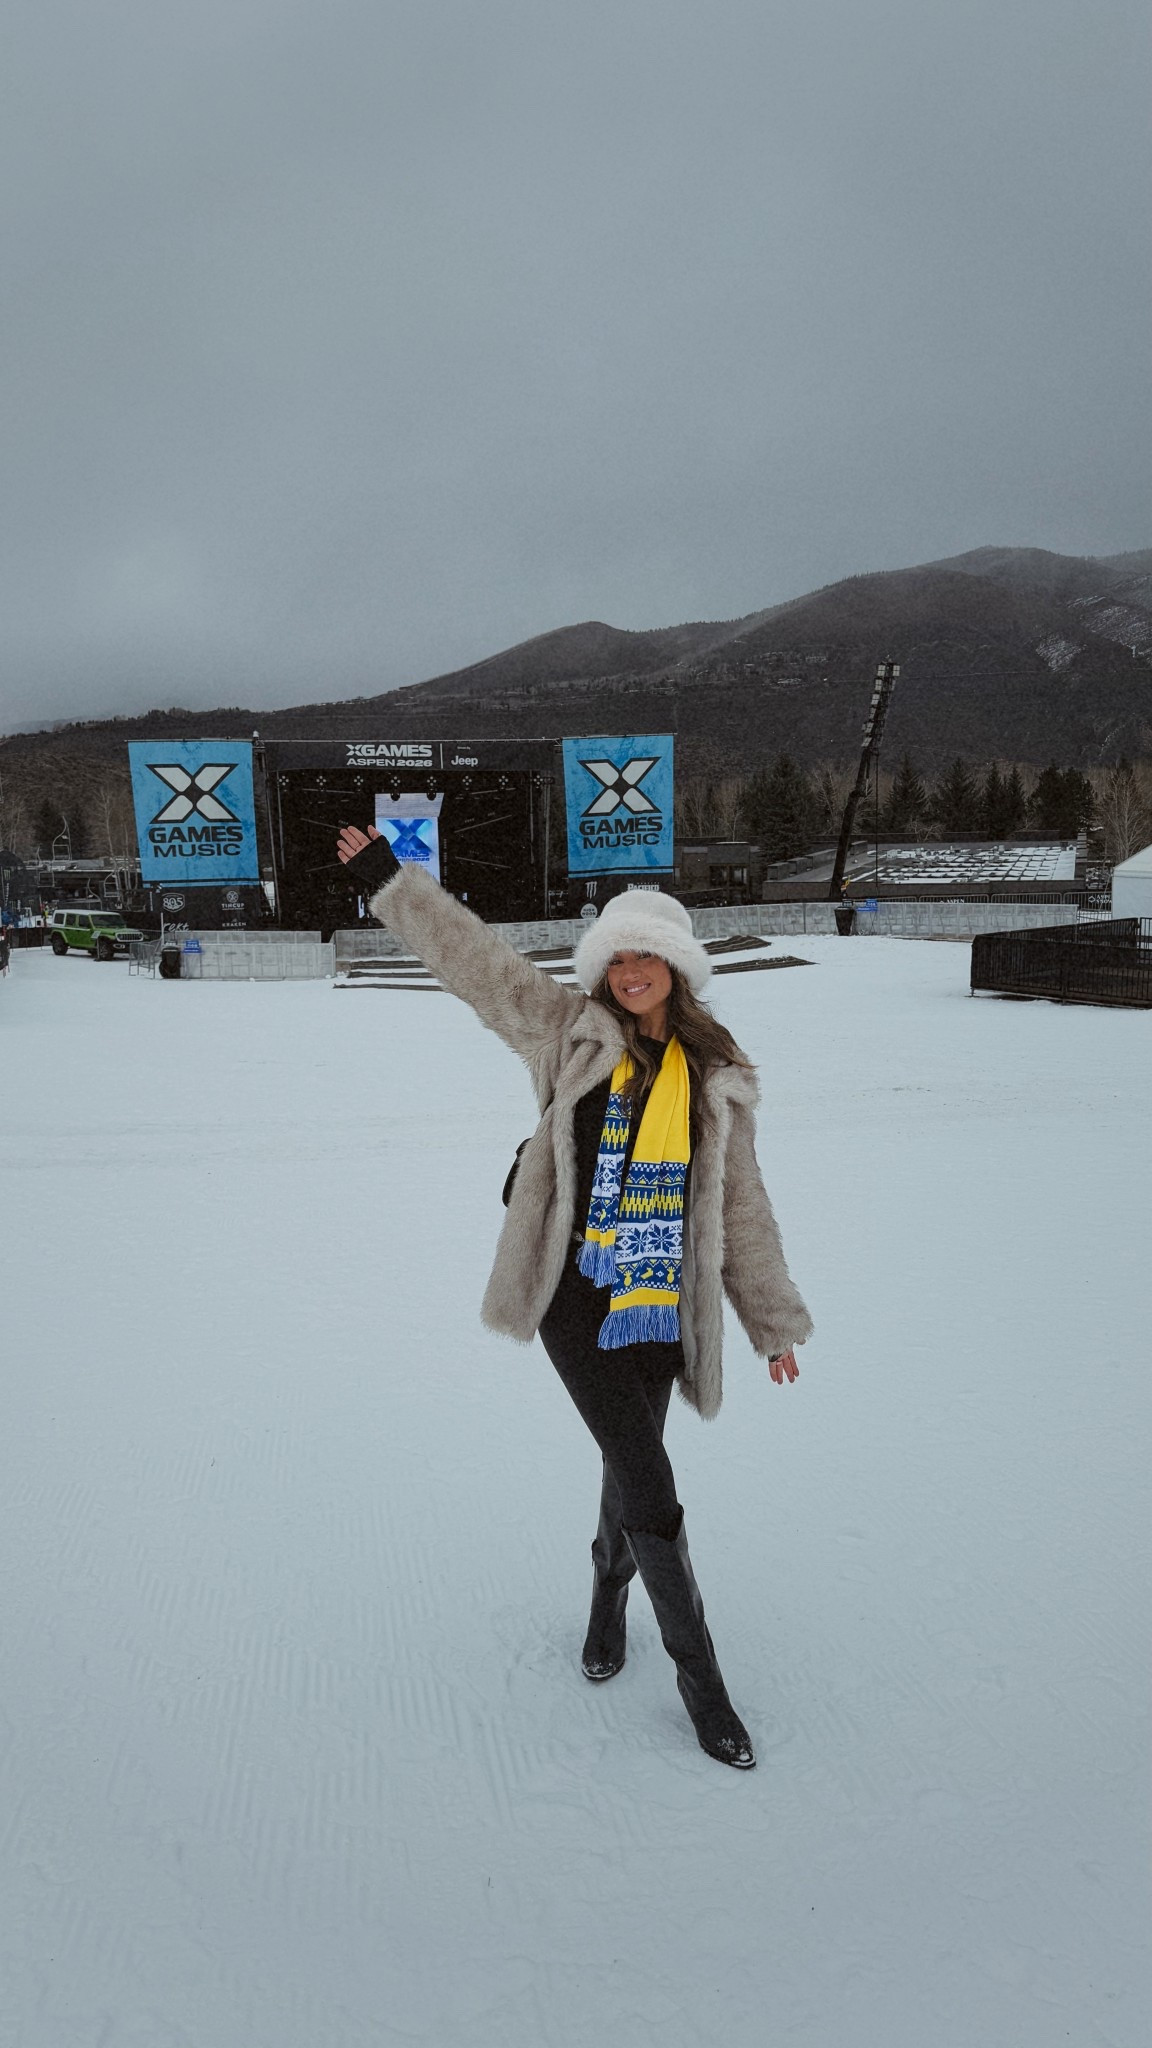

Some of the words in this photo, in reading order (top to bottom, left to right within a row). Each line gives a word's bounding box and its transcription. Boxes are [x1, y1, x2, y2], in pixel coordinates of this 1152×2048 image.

[346, 758, 396, 767] ASPEN
[397, 759, 433, 767] 2026
[451, 755, 479, 767] Jeep
[579, 816, 663, 836] GAMES
[148, 826, 243, 844] GAMES
[583, 833, 660, 850] MUSIC
[153, 843, 241, 858] MUSIC
[163, 897, 183, 908] 805
